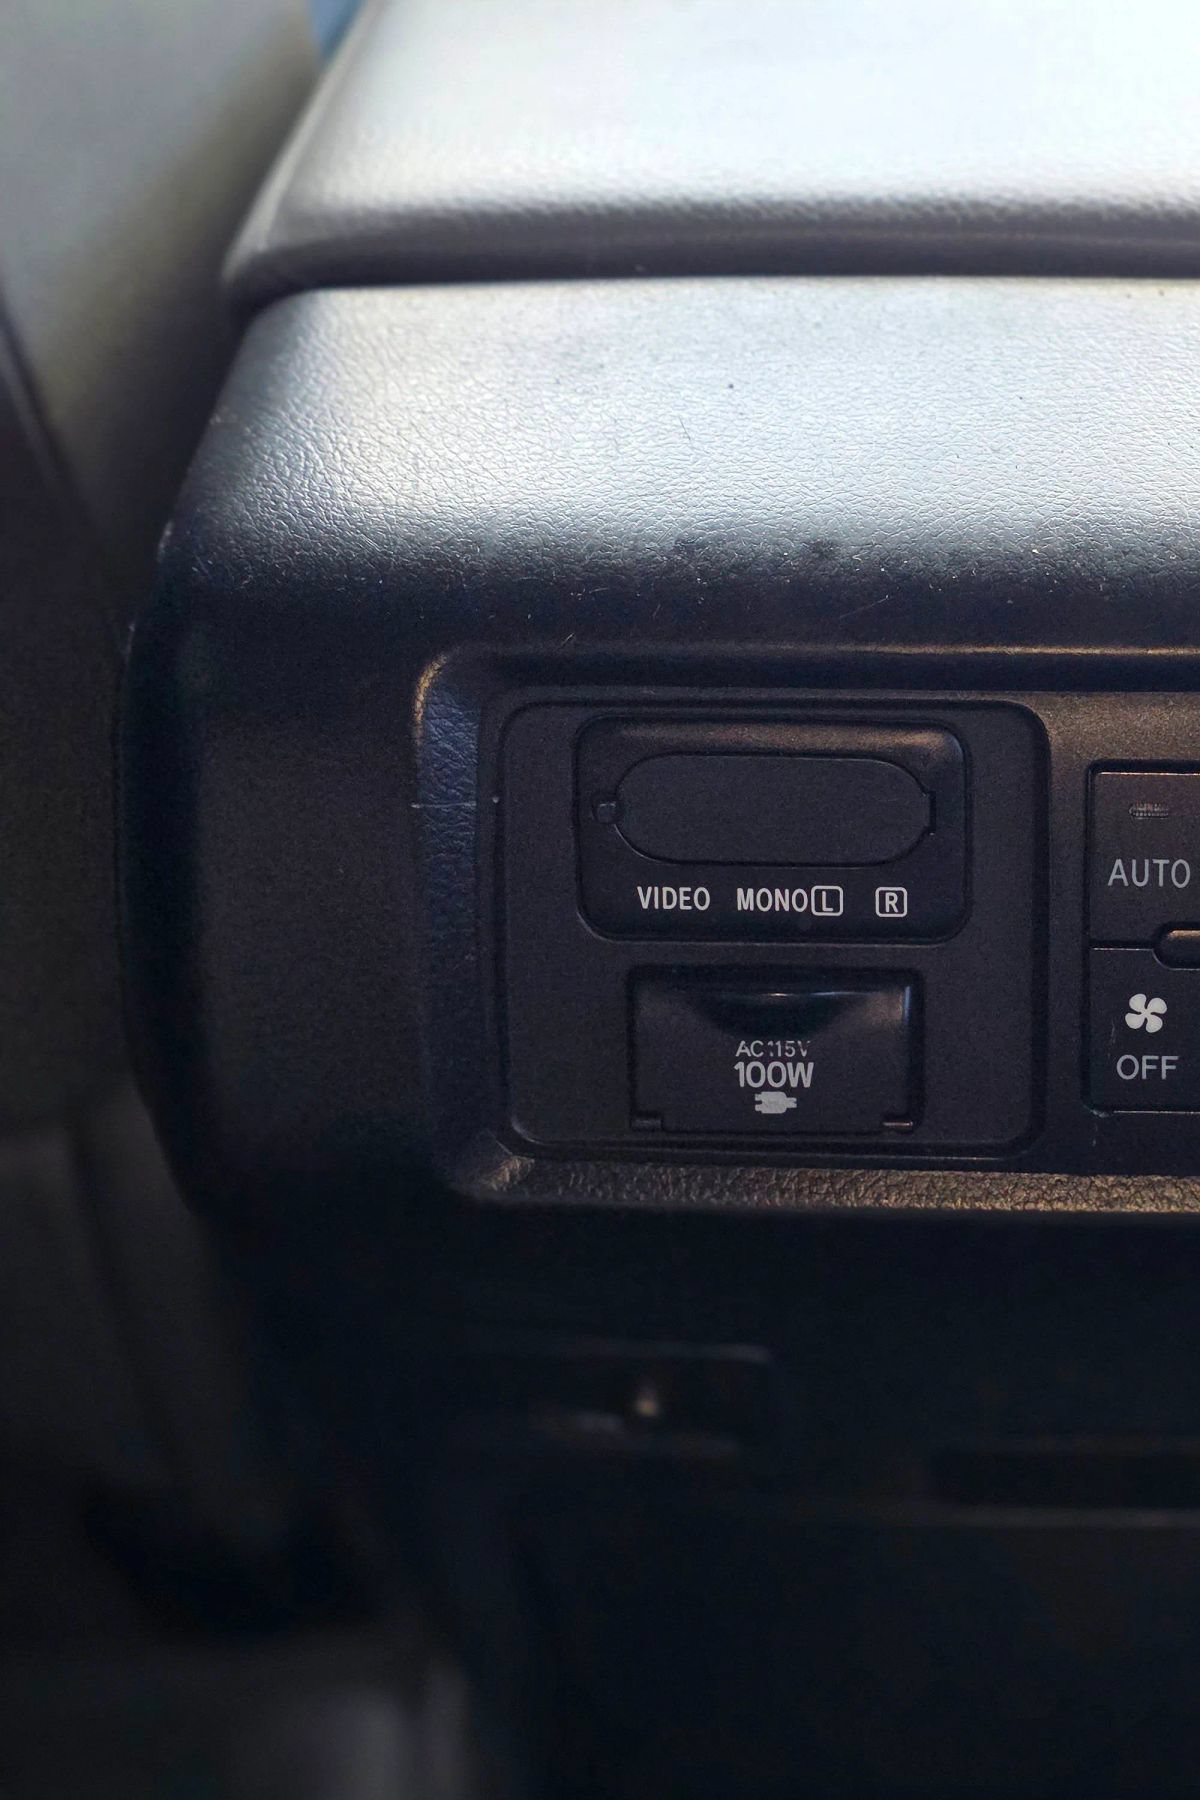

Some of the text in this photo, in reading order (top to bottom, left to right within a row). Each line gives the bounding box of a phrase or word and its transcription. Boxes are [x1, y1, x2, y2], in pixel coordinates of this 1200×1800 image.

[1108, 859, 1190, 888] AUTO
[637, 887, 710, 910] VIDEO
[737, 888, 808, 912] MONO
[734, 1062, 814, 1087] 100W
[1117, 1055, 1178, 1079] OFF
